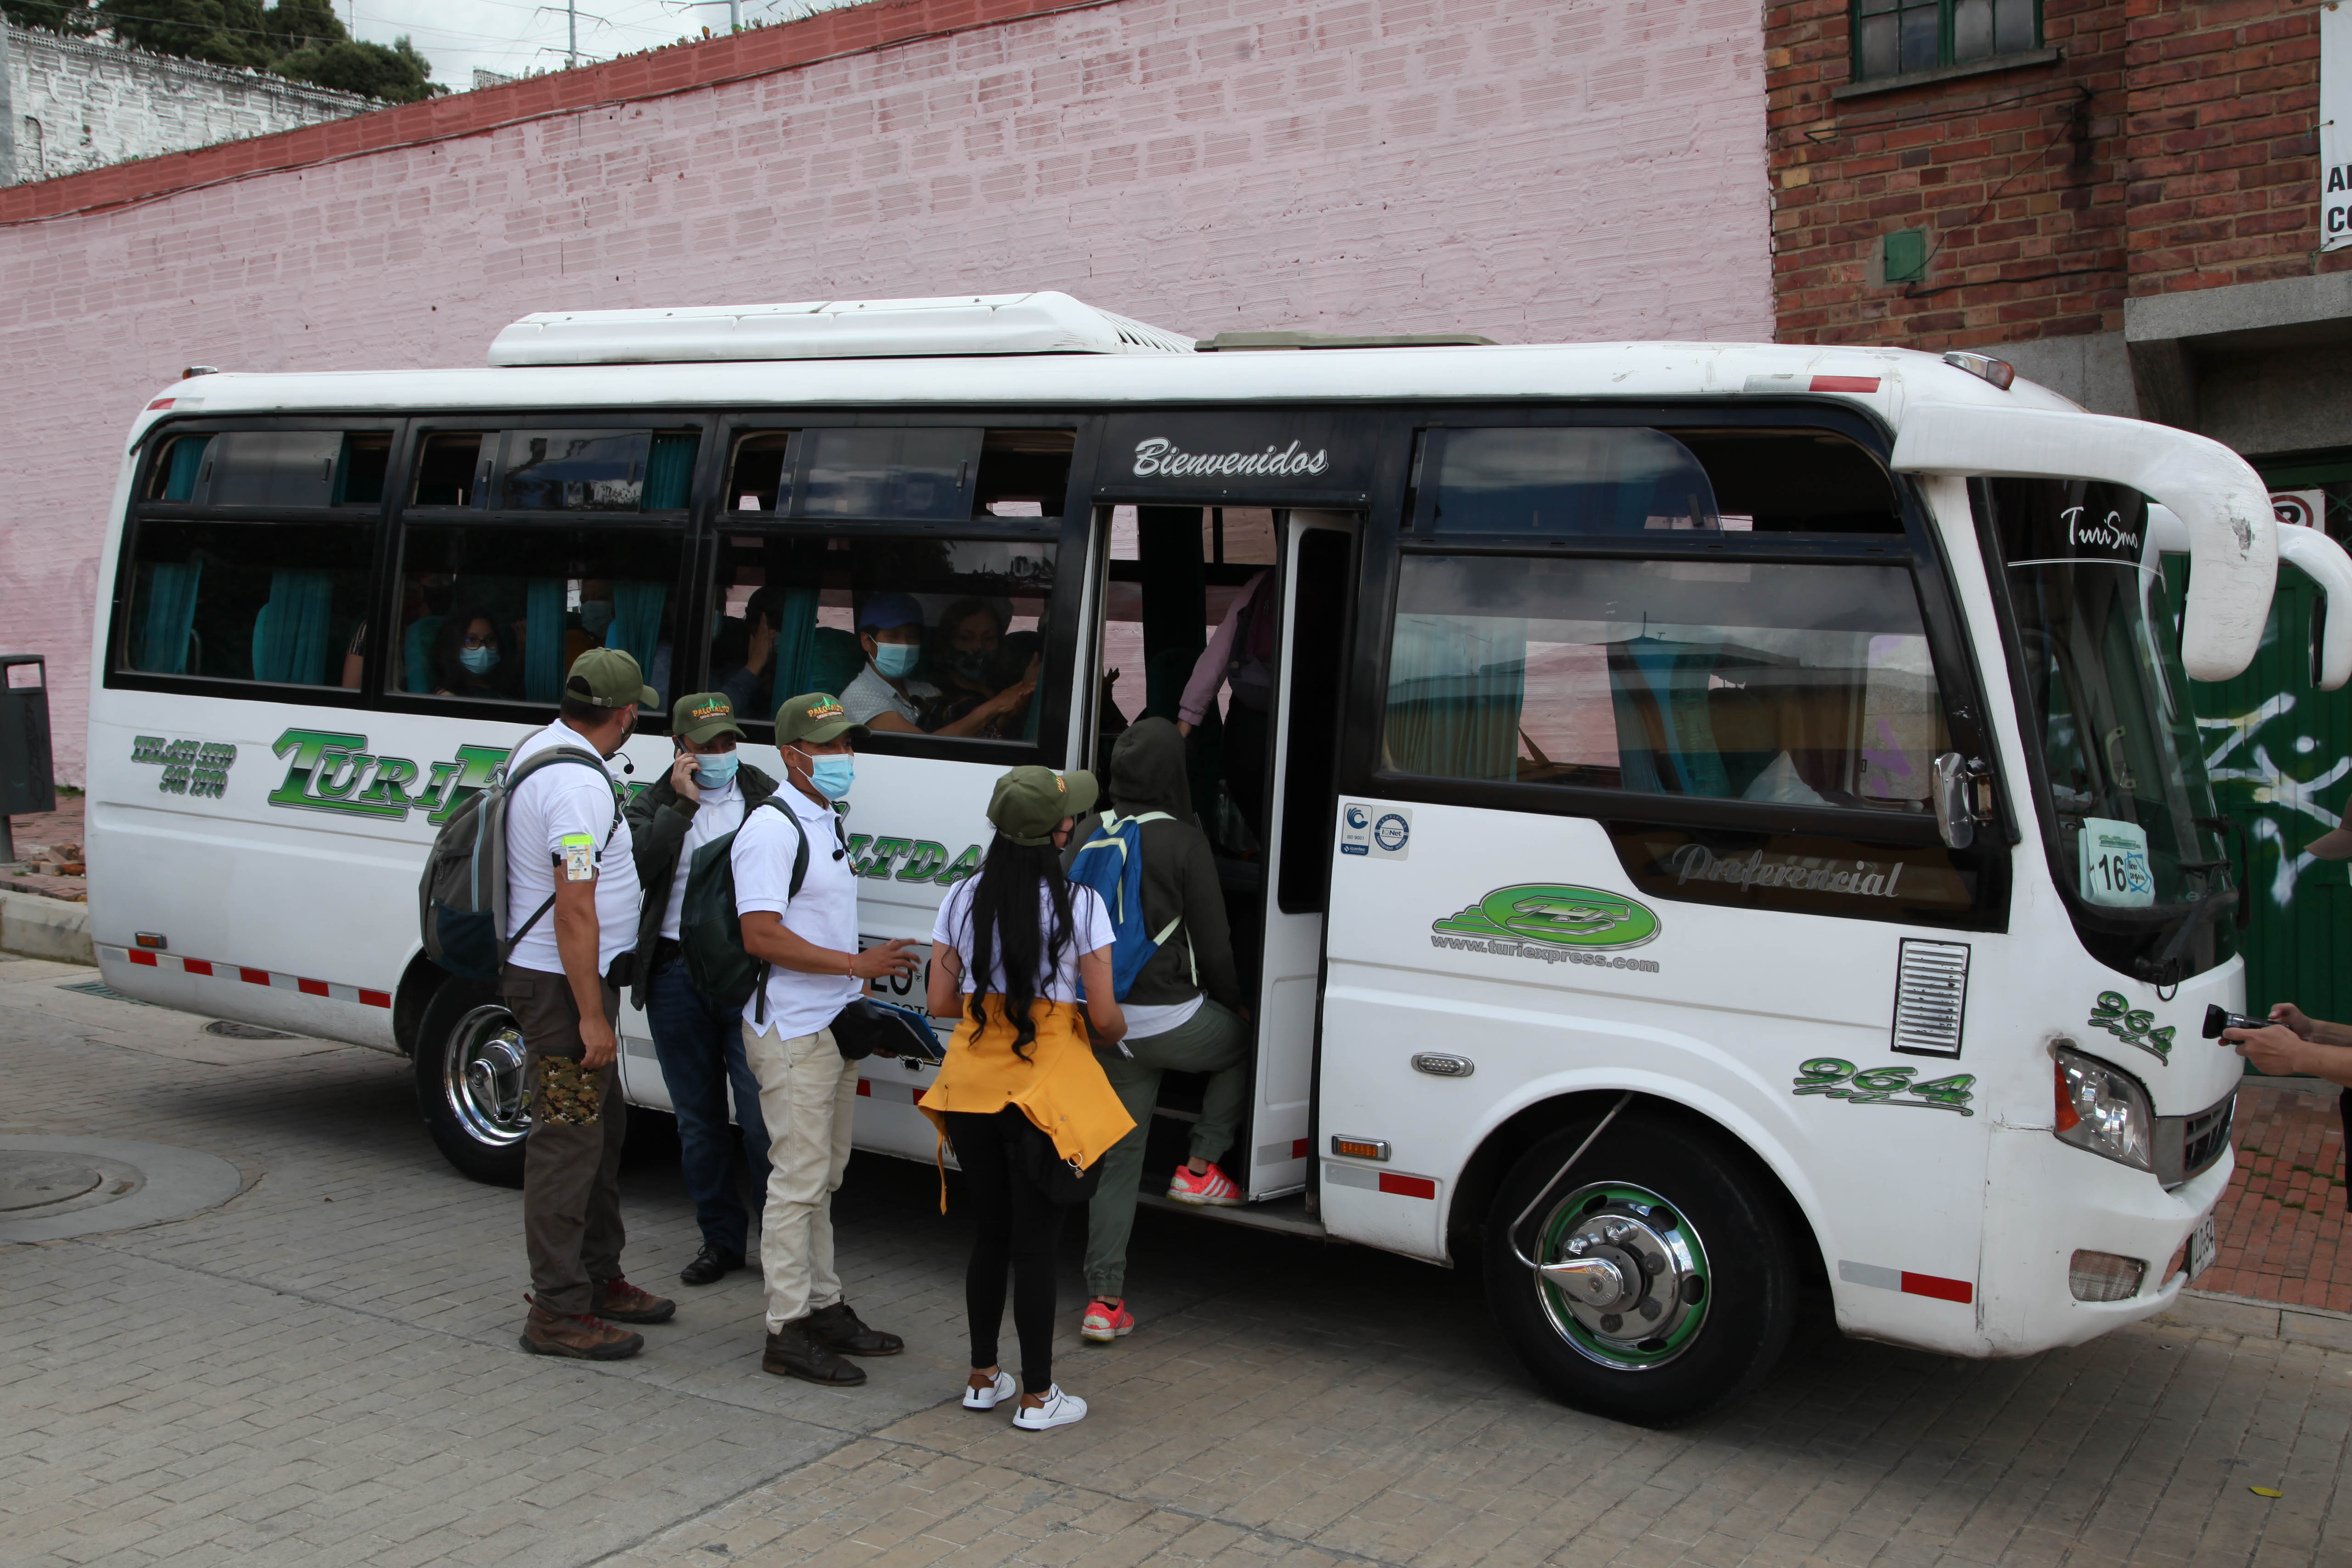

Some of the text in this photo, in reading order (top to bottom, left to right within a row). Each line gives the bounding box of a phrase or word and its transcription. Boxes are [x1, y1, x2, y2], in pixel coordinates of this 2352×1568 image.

[1133, 437, 1329, 477] Bienvenidos
[692, 707, 711, 717] PALO
[807, 705, 829, 717] PALO
[846, 833, 982, 887] LTDA
[1672, 843, 1904, 898] Preferencial
[2099, 854, 2127, 892] 16
[1431, 935, 1660, 973] www.turiexpress.com
[2090, 990, 2177, 1053] 964
[1794, 1057, 1977, 1108] 964
